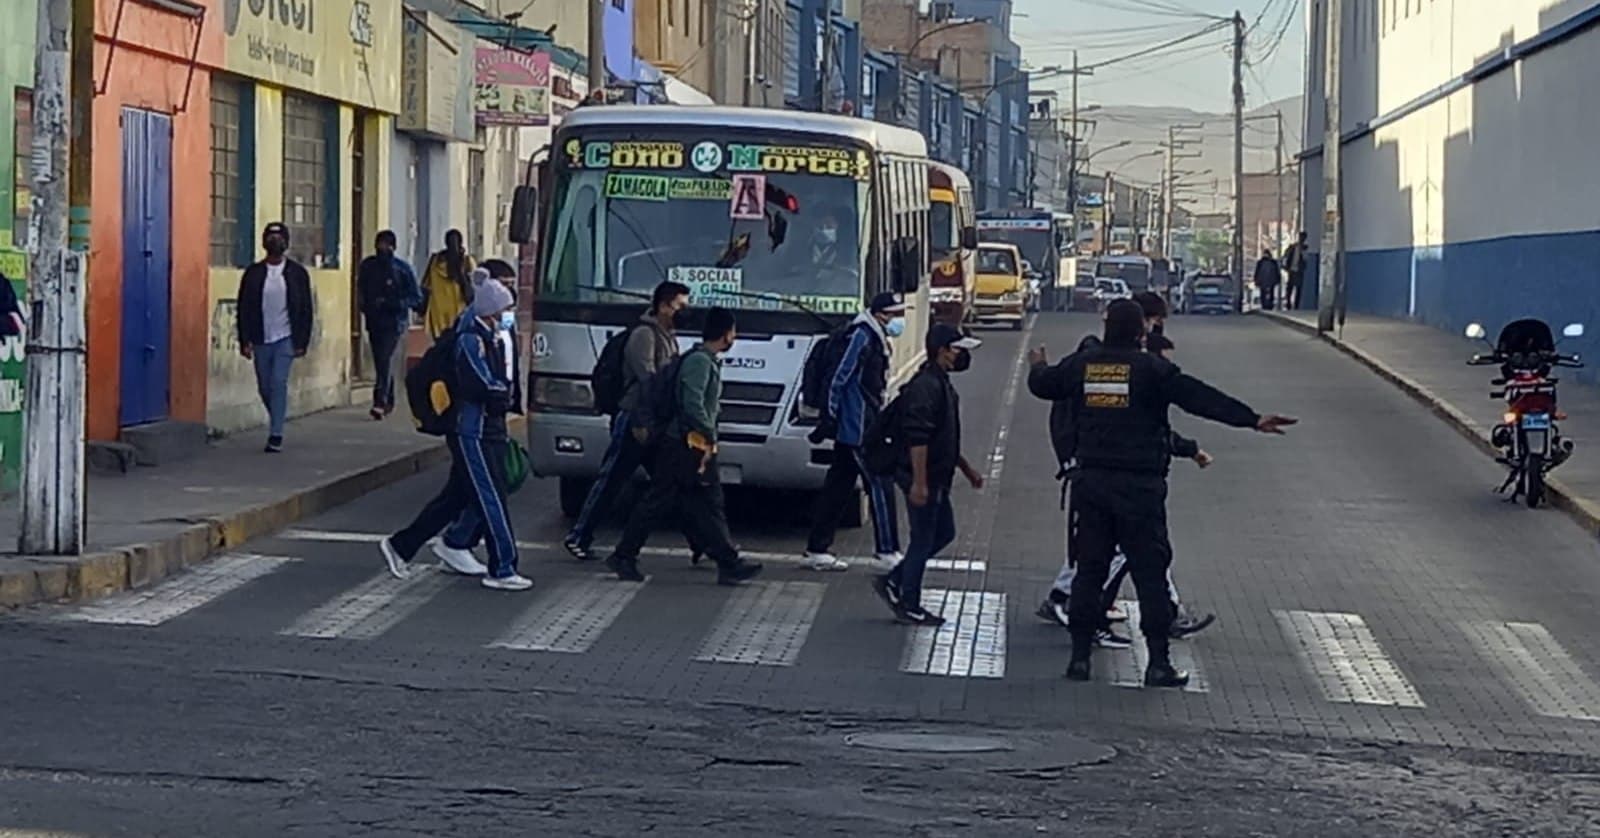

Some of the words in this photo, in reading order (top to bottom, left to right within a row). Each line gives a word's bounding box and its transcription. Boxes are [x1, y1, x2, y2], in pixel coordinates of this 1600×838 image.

[695, 146, 718, 167] C-2
[727, 144, 850, 176] Norte
[609, 176, 666, 197] ZAMACOLA
[734, 178, 760, 214] A
[671, 269, 684, 281] S.
[689, 269, 738, 283] SOCIAL
